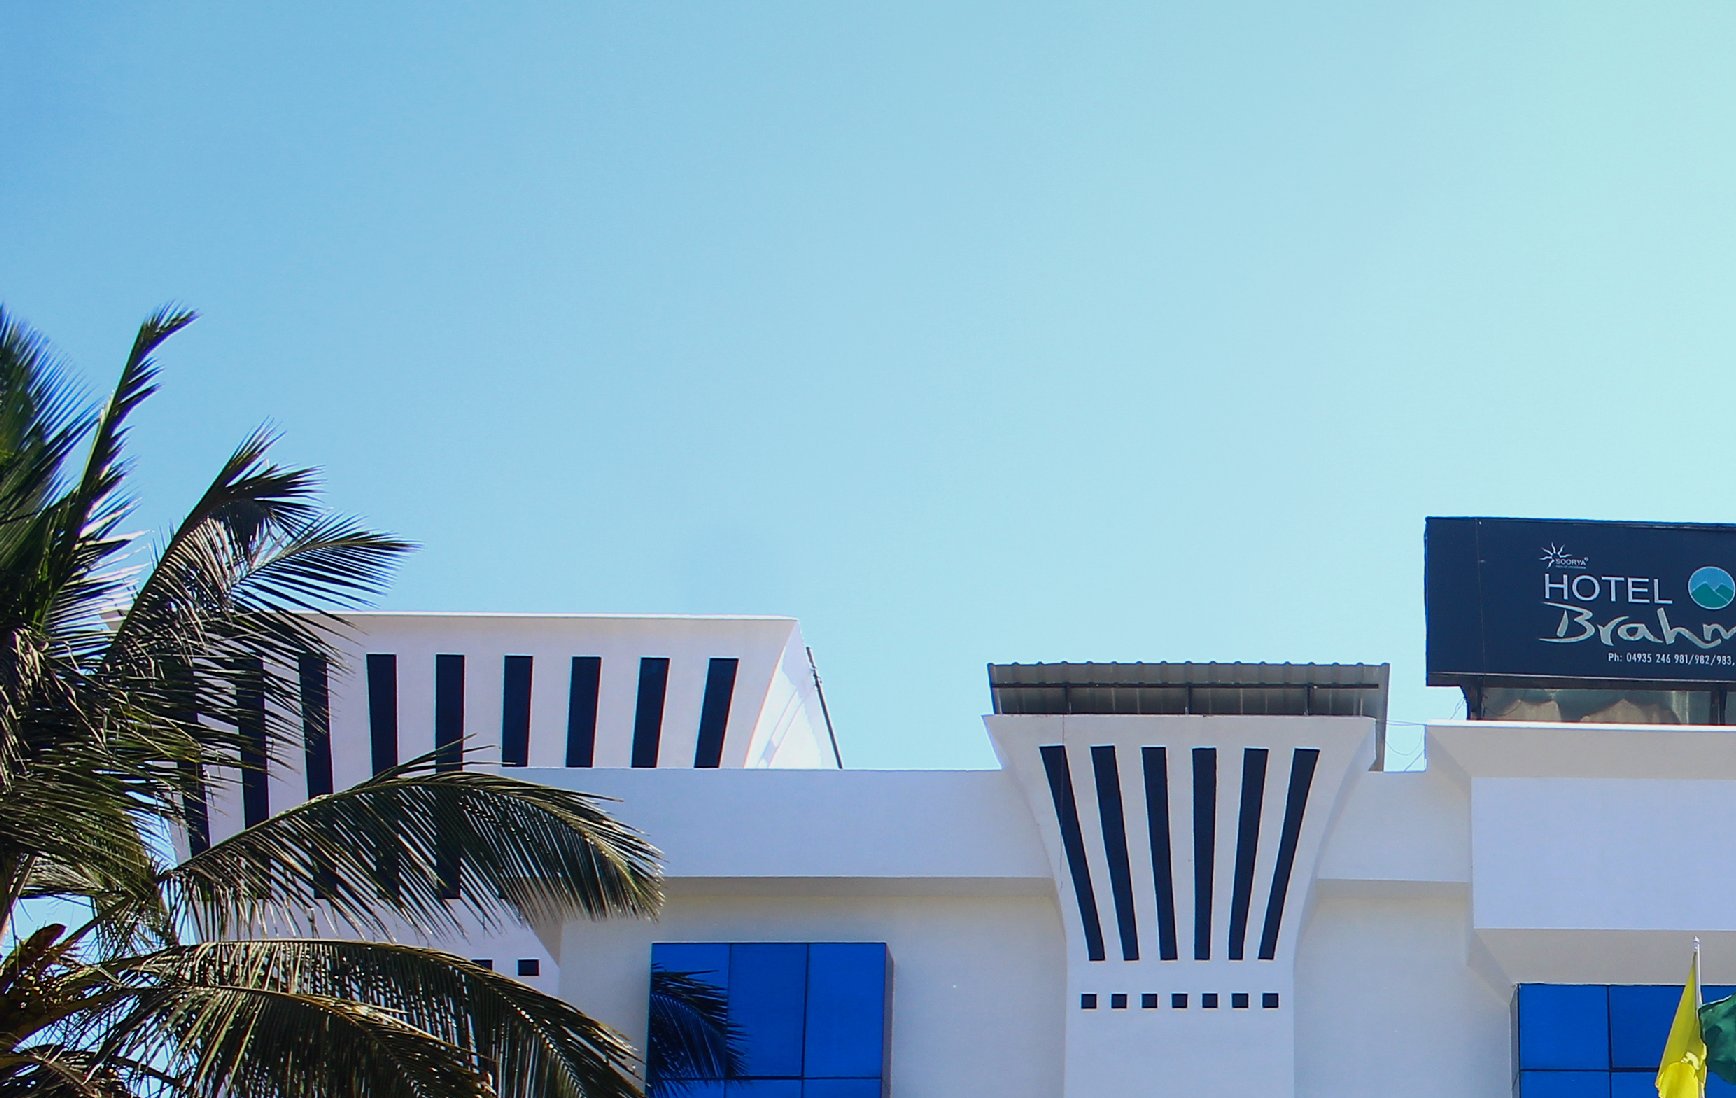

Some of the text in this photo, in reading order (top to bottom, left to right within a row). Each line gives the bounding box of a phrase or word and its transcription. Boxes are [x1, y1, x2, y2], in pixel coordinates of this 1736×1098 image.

[1544, 573, 1673, 605] HOTEL
[1608, 652, 1622, 662] Ph:
[1626, 653, 1652, 663] 04935
[1655, 653, 1671, 664] 246
